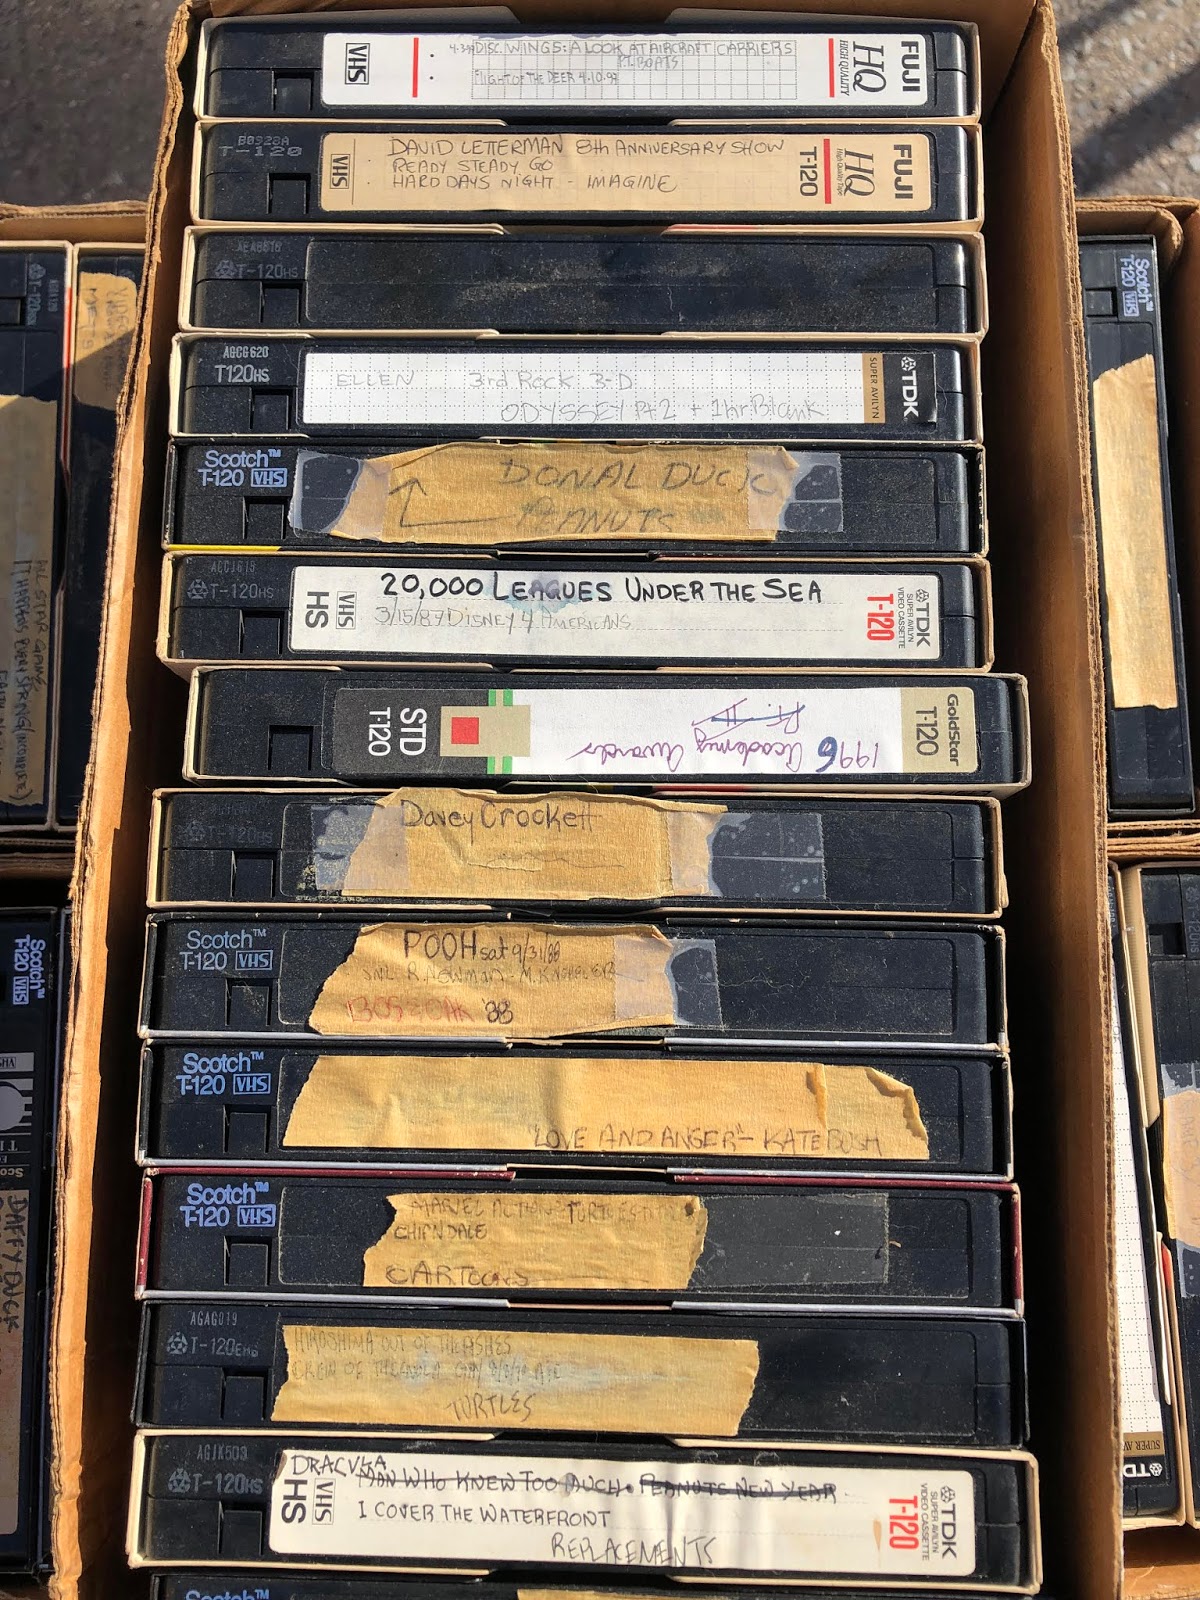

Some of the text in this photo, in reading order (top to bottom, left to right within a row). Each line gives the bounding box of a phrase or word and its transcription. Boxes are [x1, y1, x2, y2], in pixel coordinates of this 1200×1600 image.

[346, 43, 369, 84] VHS
[571, 41, 582, 54] A
[585, 41, 623, 55] LOOK
[629, 43, 647, 55] AT
[650, 43, 712, 55] AIRCRAFT
[717, 43, 793, 56] CARRIERS
[901, 41, 920, 92] FUJI
[526, 71, 544, 85] THE
[547, 70, 576, 84] DEER
[839, 40, 849, 96] HIGH QUALITY
[852, 41, 887, 94] HQ
[218, 146, 303, 157] T-120
[387, 135, 453, 156] DAVID
[461, 135, 564, 156] LETTERMAN
[614, 138, 726, 157] ANNIVERSARY
[730, 139, 785, 155] SHOW
[332, 154, 349, 188] VHS
[391, 158, 554, 174] READY STEADY GO
[392, 174, 678, 192] HARD DAYS NIGHT IMAGINE
[800, 146, 818, 197] T-120
[843, 148, 875, 198] HQ
[893, 143, 914, 200] FUJI
[1120, 254, 1139, 316] T-120 VHS
[214, 364, 270, 383] T120HS
[336, 369, 633, 391] ELLEN 3rd Rock 3-D
[868, 357, 879, 420] SUPER AVILYN
[501, 402, 626, 424] ODYSSEY
[902, 370, 919, 419] TDK
[198, 469, 285, 488] T-120 VHS
[500, 459, 639, 490] DONAL
[210, 583, 274, 601] T-120HS
[381, 571, 822, 604] 20,000 LEAGUES UNDER THE SEA
[306, 590, 330, 628] HS
[337, 592, 355, 628] VHS
[374, 599, 446, 627] 3/15/87
[866, 593, 895, 642] T-120
[896, 586, 906, 649] VIDEO CASSETTE
[905, 593, 914, 643] SUPER AVILYN
[915, 603, 931, 647] TDK
[368, 706, 391, 757] T-120
[400, 707, 427, 757] STD
[915, 706, 939, 756] T-120
[946, 693, 961, 767] GoldStar
[401, 801, 595, 845] Davey Crockett
[180, 952, 271, 971] T-120 VHS
[403, 929, 477, 961] POOH
[480, 935, 508, 961] sat
[14, 934, 31, 1004] T-120 VHS
[175, 1075, 269, 1095] T-120 VHS
[598, 1123, 653, 1150] AND
[763, 1126, 820, 1156] KATE
[179, 1206, 273, 1227] T-120 VHS
[2, 1193, 29, 1334] DAFFY DUCK
[294, 1329, 374, 1354] HIROSHIMA
[447, 1390, 537, 1422] TURTLES
[1135, 1439, 1161, 1451] SUPER
[192, 1473, 264, 1495] T-120HS
[403, 1467, 446, 1491] WHO
[456, 1470, 516, 1493] KNEW
[519, 1470, 558, 1491] TOO
[281, 1478, 309, 1524] HS
[313, 1480, 334, 1524] VHS
[359, 1501, 611, 1529] I COVER THE WATERFRONT
[888, 1495, 919, 1551] T-120
[920, 1483, 931, 1561] VIDEO CASSETTE
[930, 1490, 940, 1554] SUPER AVILYN
[942, 1502, 957, 1559] TDK
[551, 1531, 716, 1567] REPLACEMENTS
